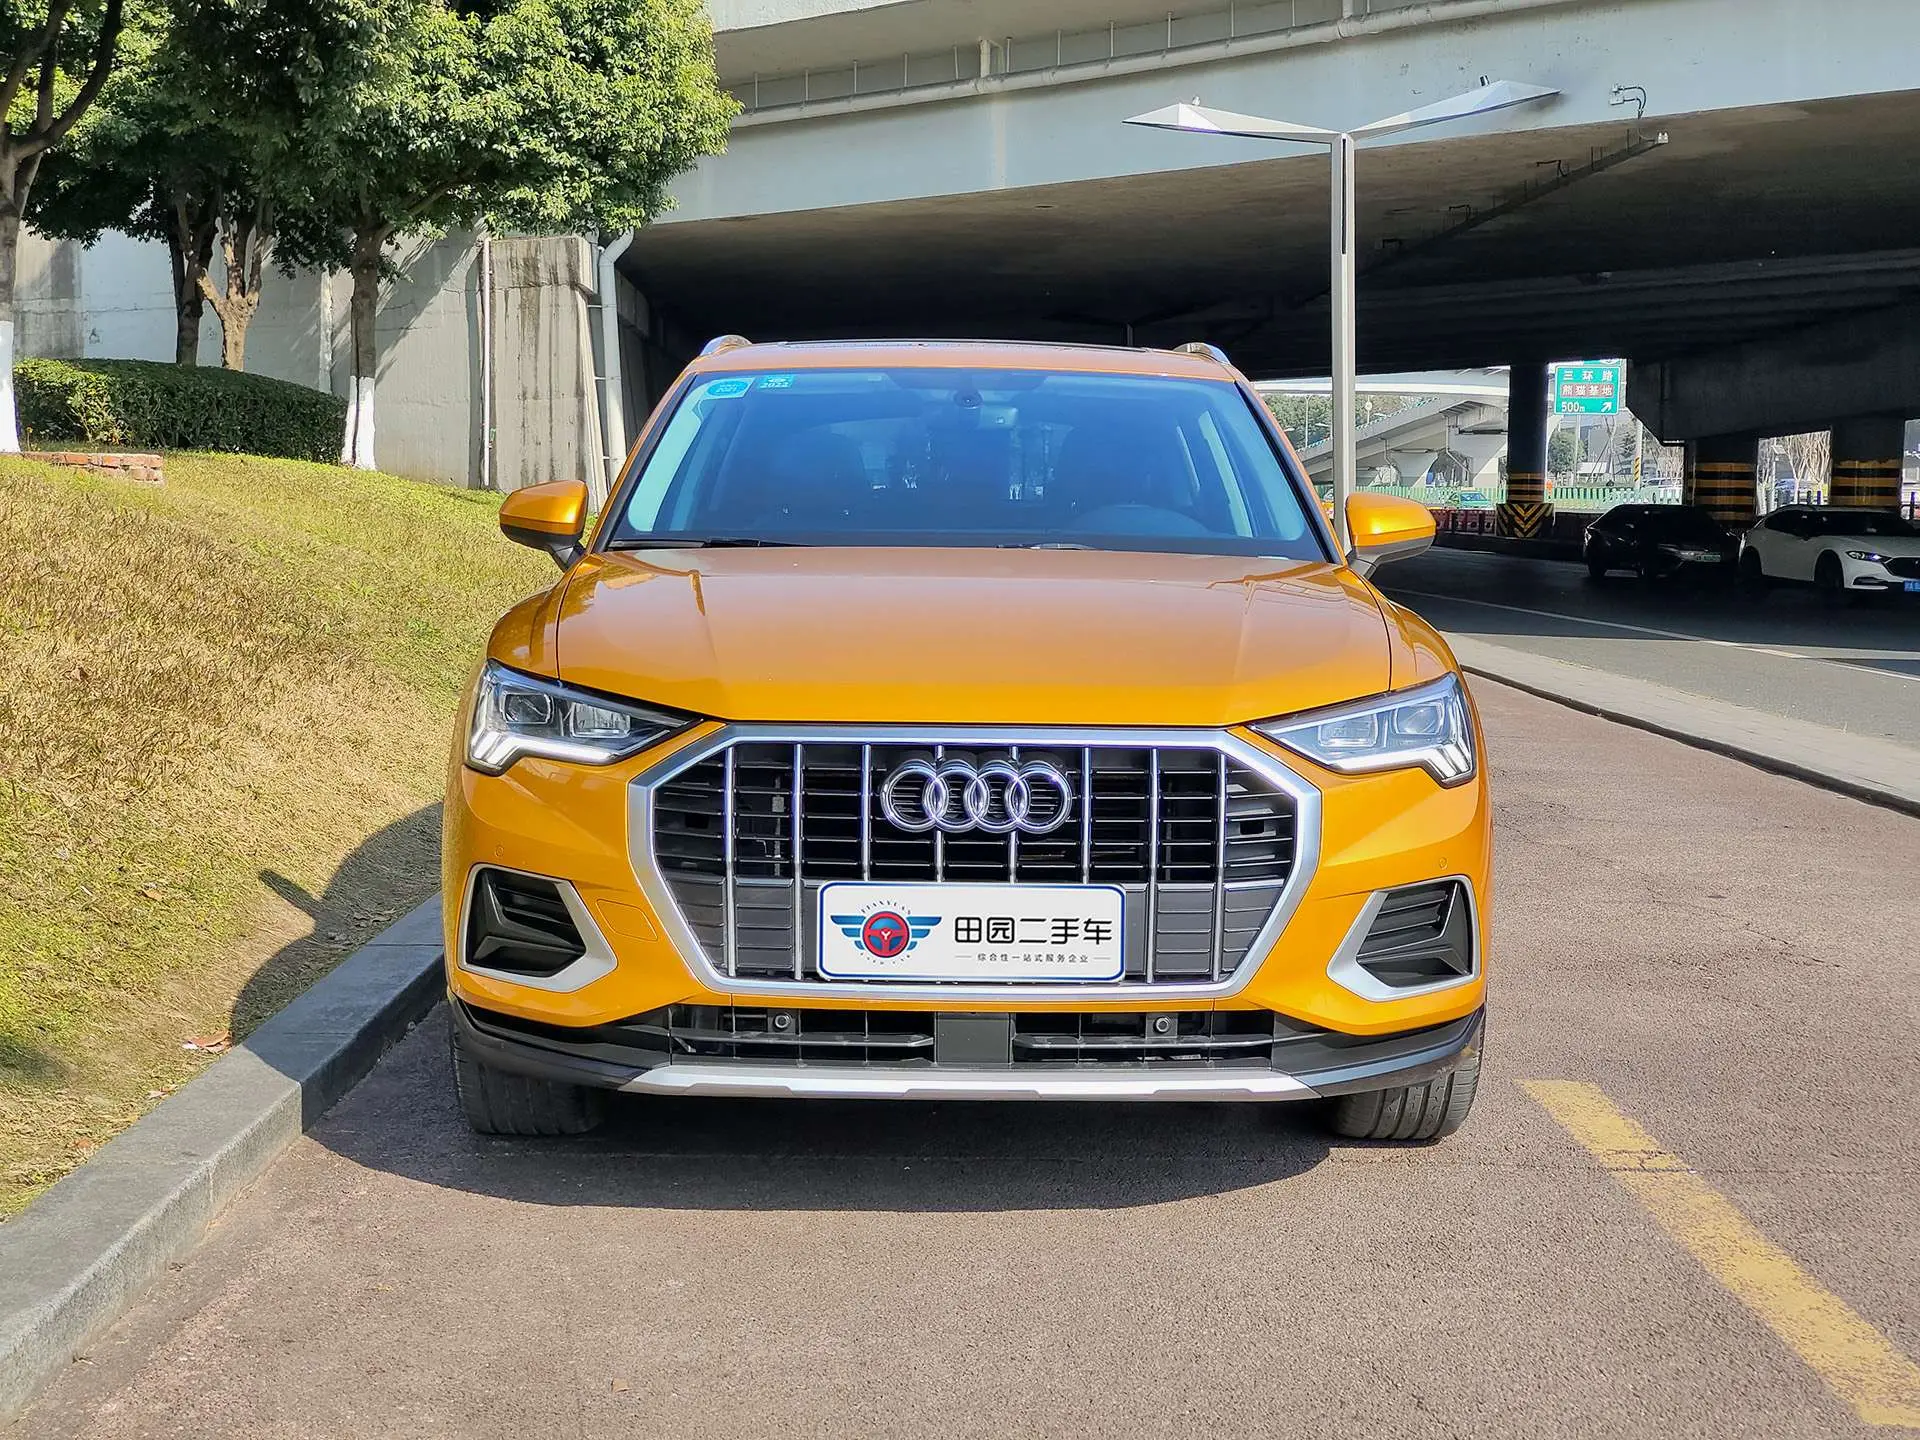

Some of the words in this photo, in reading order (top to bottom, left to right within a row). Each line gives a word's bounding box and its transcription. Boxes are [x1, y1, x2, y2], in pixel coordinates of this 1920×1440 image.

[1563, 369, 1613, 381] 三环路
[1561, 401, 1585, 412] 500m
[954, 916, 1113, 945] 田园二手车
[977, 953, 1089, 963] 综合性一站式服务企业
